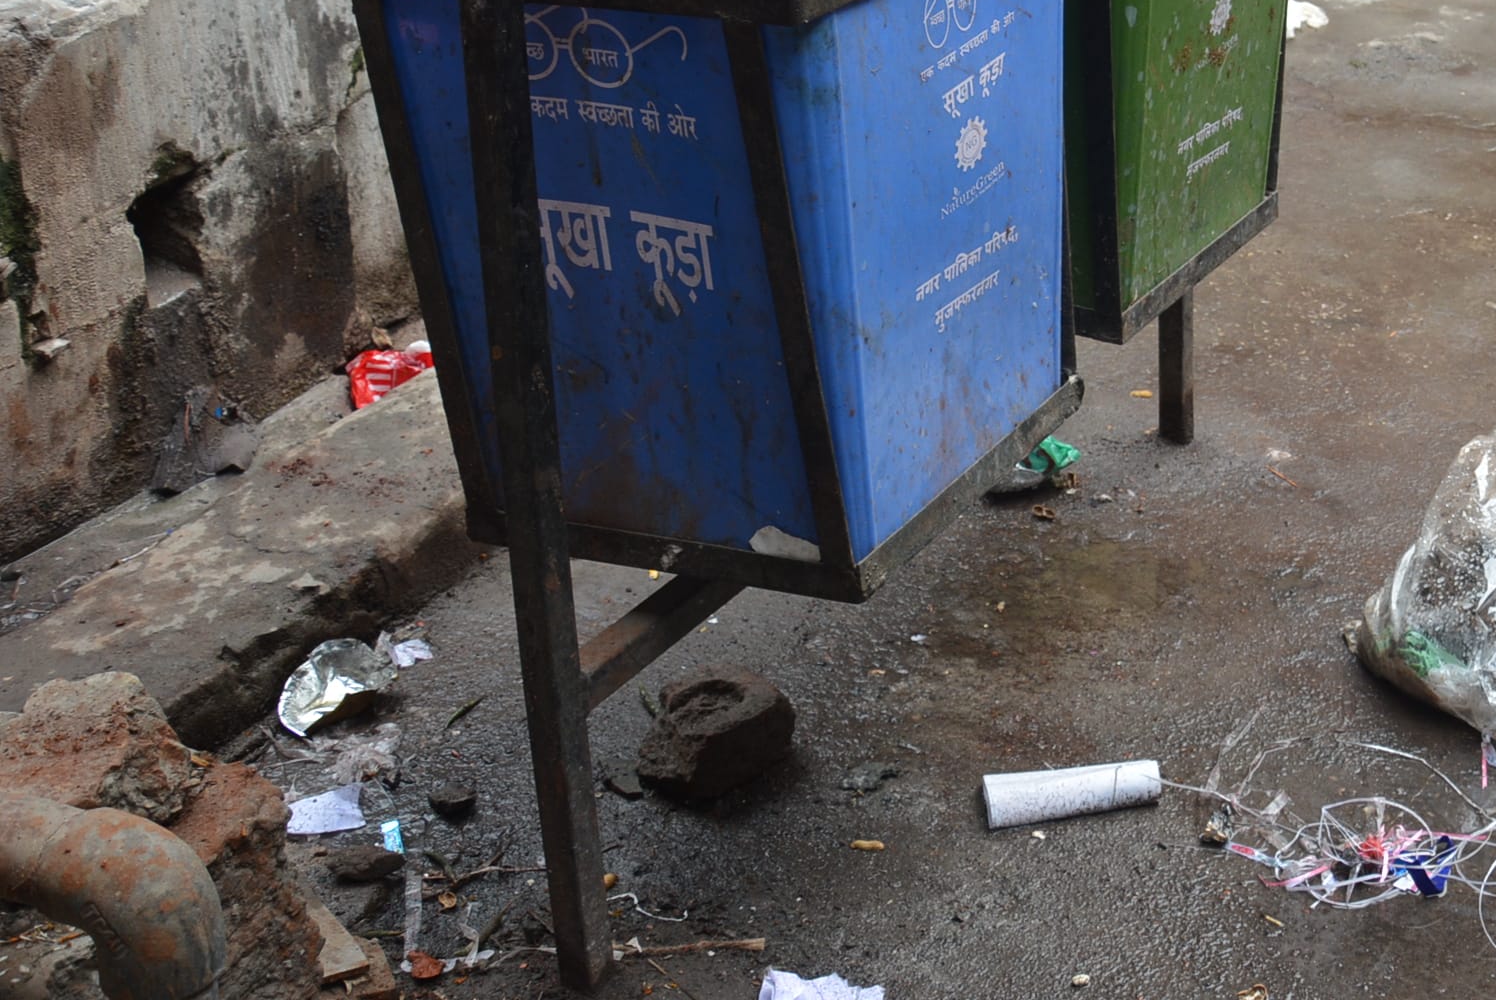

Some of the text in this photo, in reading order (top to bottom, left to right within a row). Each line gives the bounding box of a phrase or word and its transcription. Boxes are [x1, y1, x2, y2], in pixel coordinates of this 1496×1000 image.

[582, 48, 619, 68] भारत
[921, 65, 934, 82] एक
[937, 50, 957, 70] कदम
[990, 19, 1000, 34] की
[942, 52, 1006, 119] सूखा कूड़ा
[575, 98, 635, 129] स्वच्छता
[640, 100, 660, 133] की
[667, 104, 698, 140] ओर
[941, 161, 1005, 219] NatureGreen
[629, 210, 715, 317] कूड़ा
[916, 273, 941, 301] नगर
[943, 248, 982, 282] पालिका
[935, 270, 1000, 333] मुजफ्फरनगर
